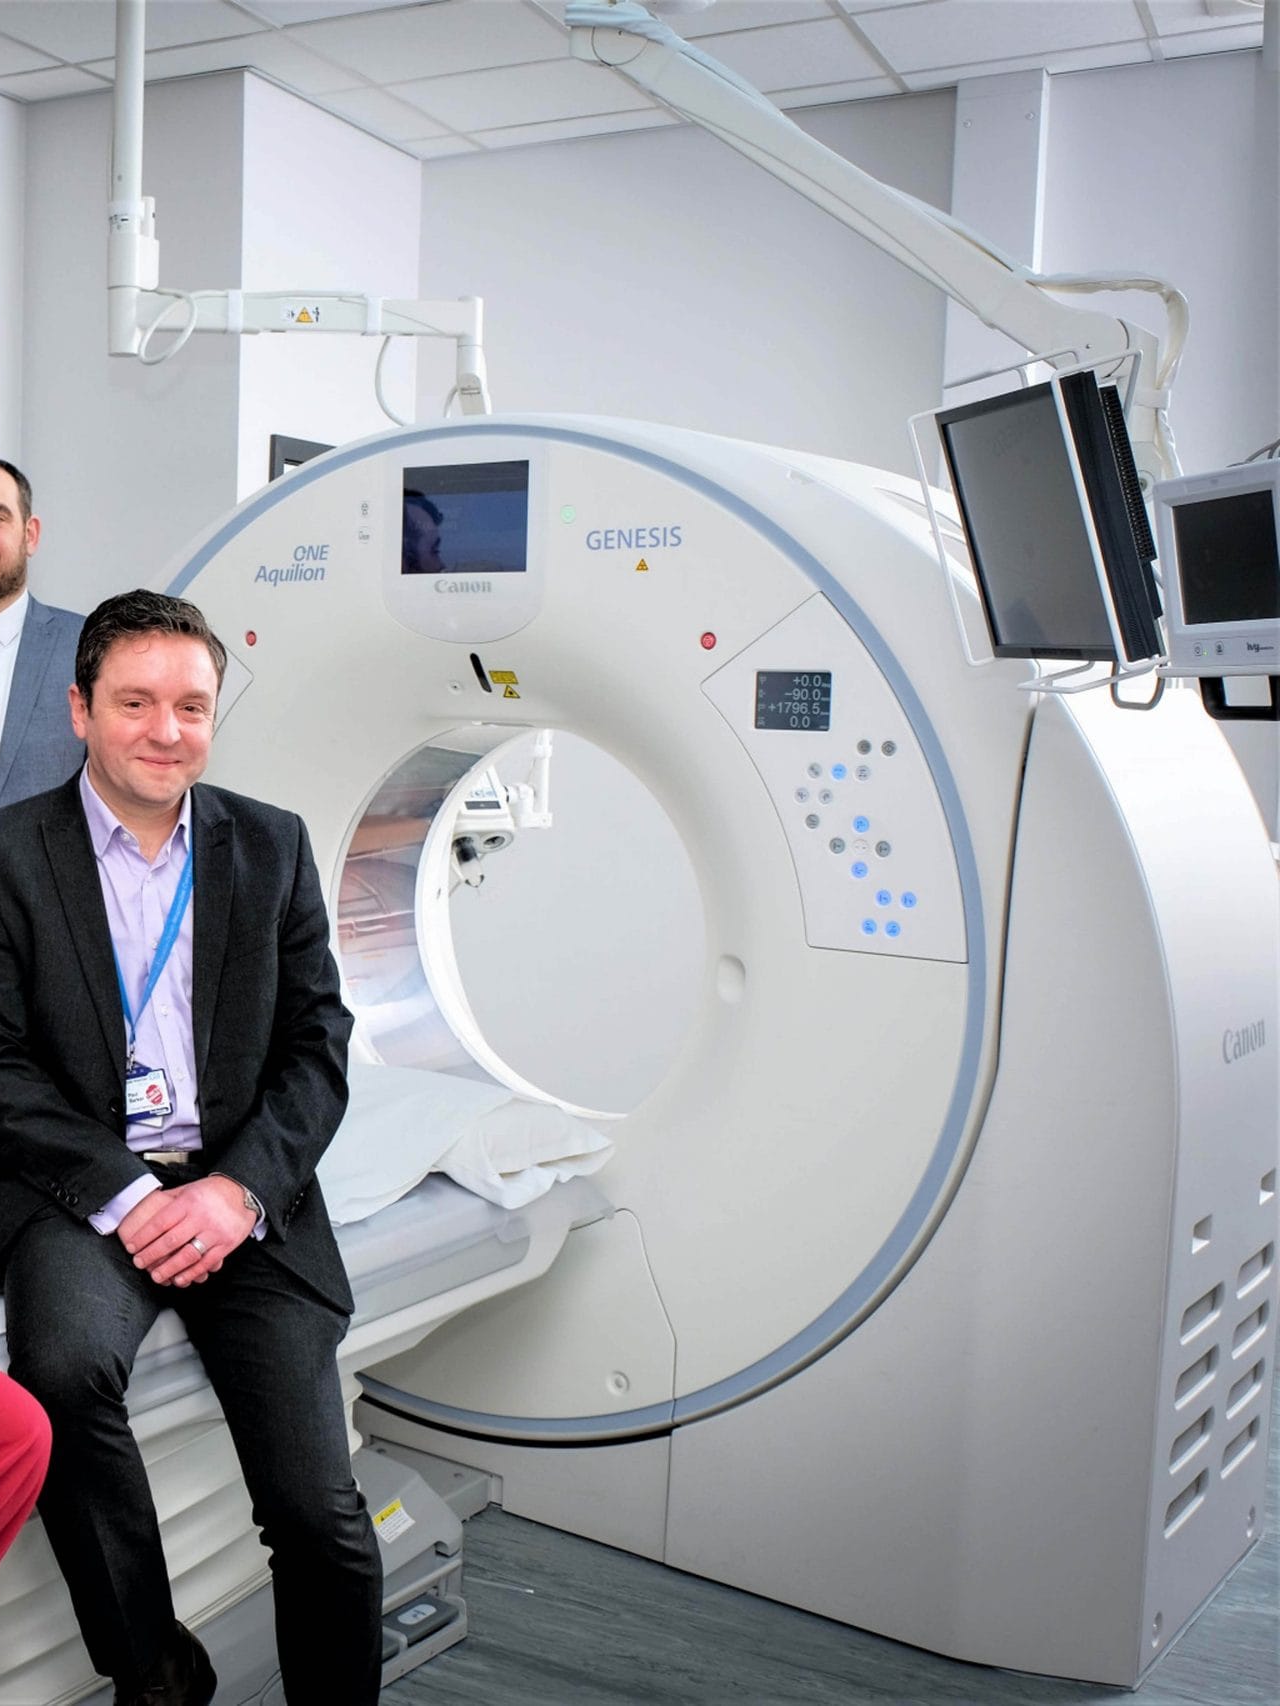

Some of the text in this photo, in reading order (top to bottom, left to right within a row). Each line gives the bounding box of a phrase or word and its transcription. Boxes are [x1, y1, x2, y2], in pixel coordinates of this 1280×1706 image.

[586, 526, 683, 551] GENESIS
[293, 544, 330, 562] ONE
[254, 563, 325, 587] Aquilion
[434, 579, 492, 594] Canon
[789, 715, 811, 728] 0.0
[1222, 1018, 1266, 1064] Canon
